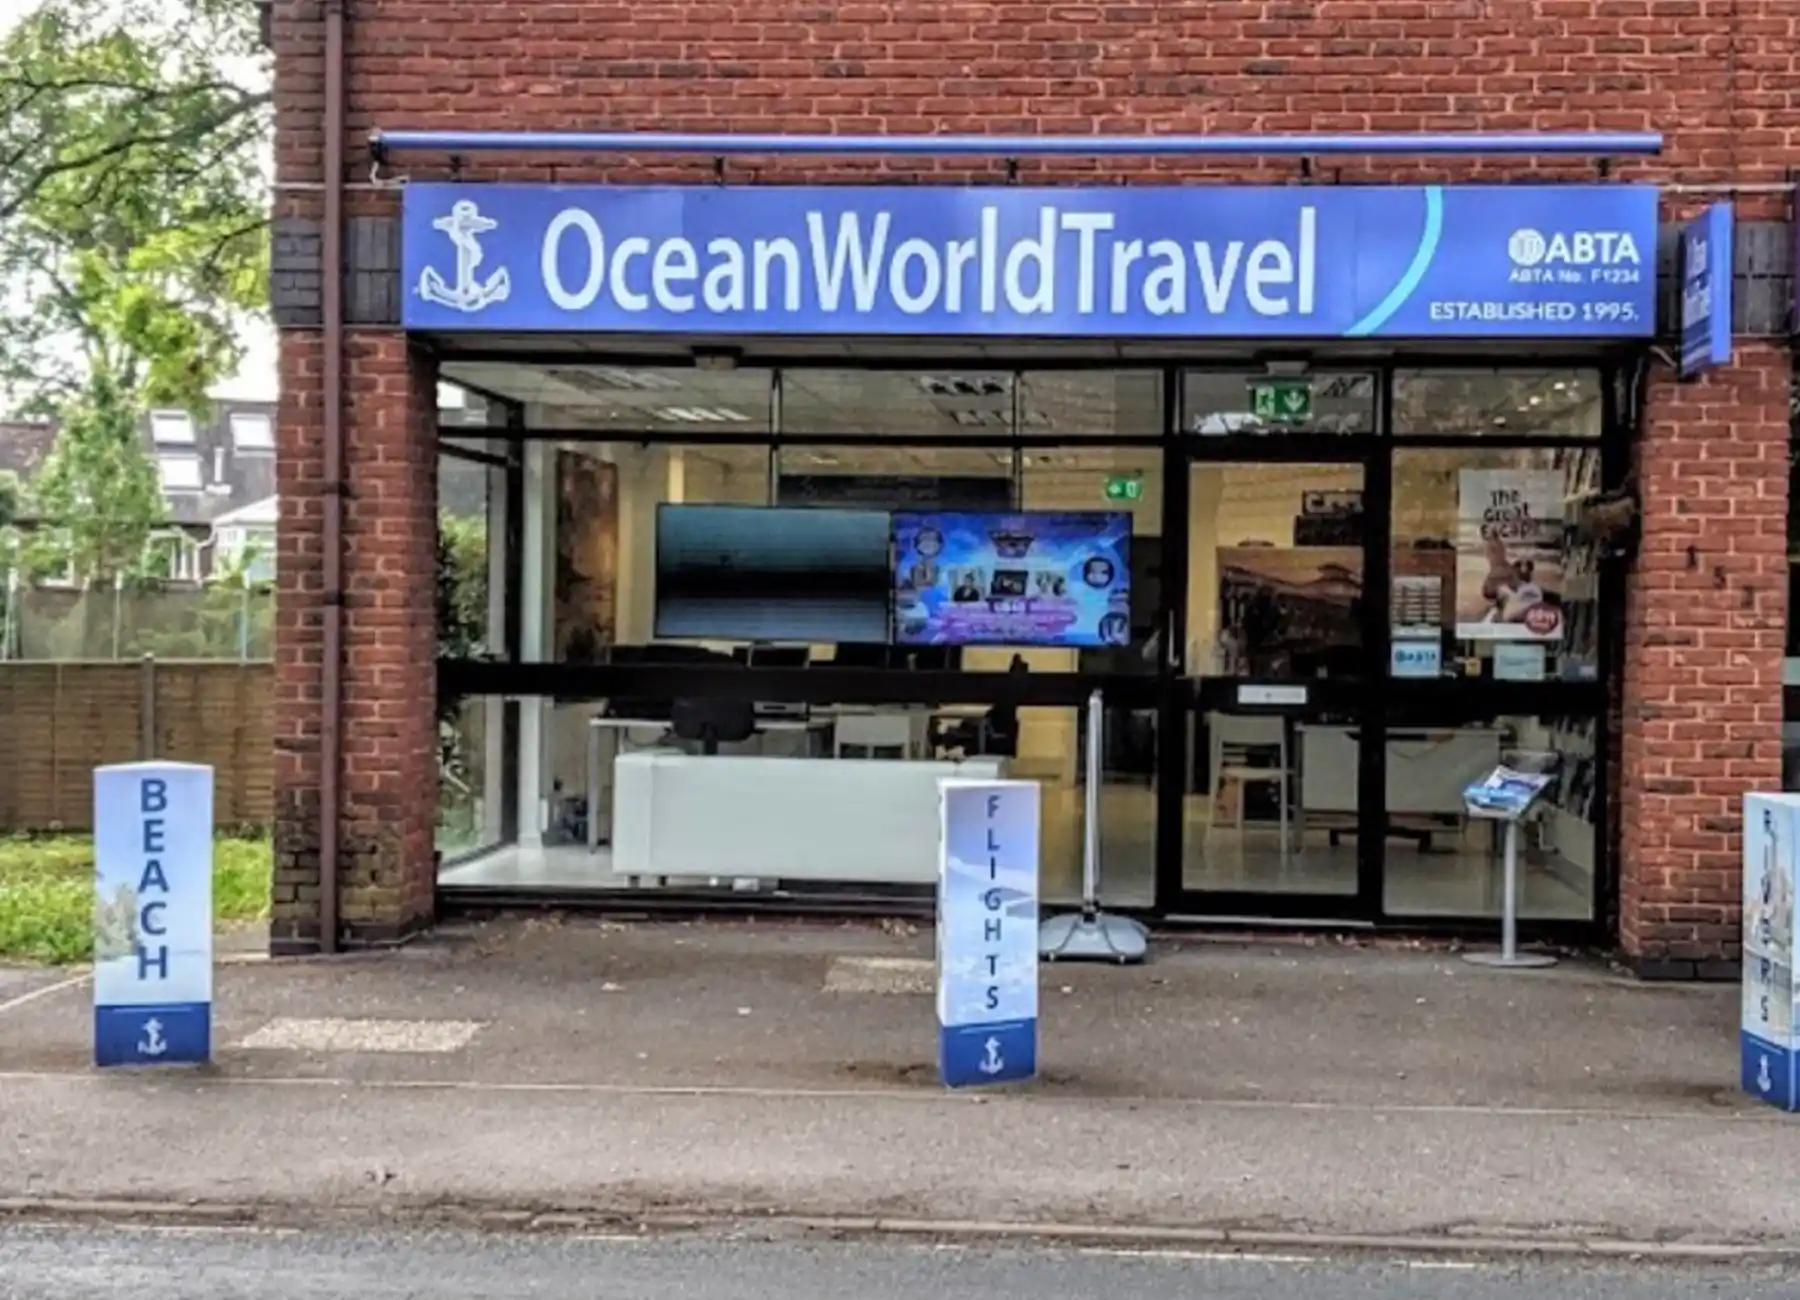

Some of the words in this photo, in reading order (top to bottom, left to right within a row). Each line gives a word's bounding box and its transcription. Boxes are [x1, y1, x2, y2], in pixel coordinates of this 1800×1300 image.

[1545, 231, 1641, 264] ABTA
[1508, 268, 1553, 283] ABTA
[1591, 268, 1640, 284] F1234
[1430, 302, 1576, 321] ESTABLISHED
[1582, 302, 1640, 322] 1995.
[137, 778, 170, 980] BEACH
[984, 796, 1002, 1009] FLIGHTS
